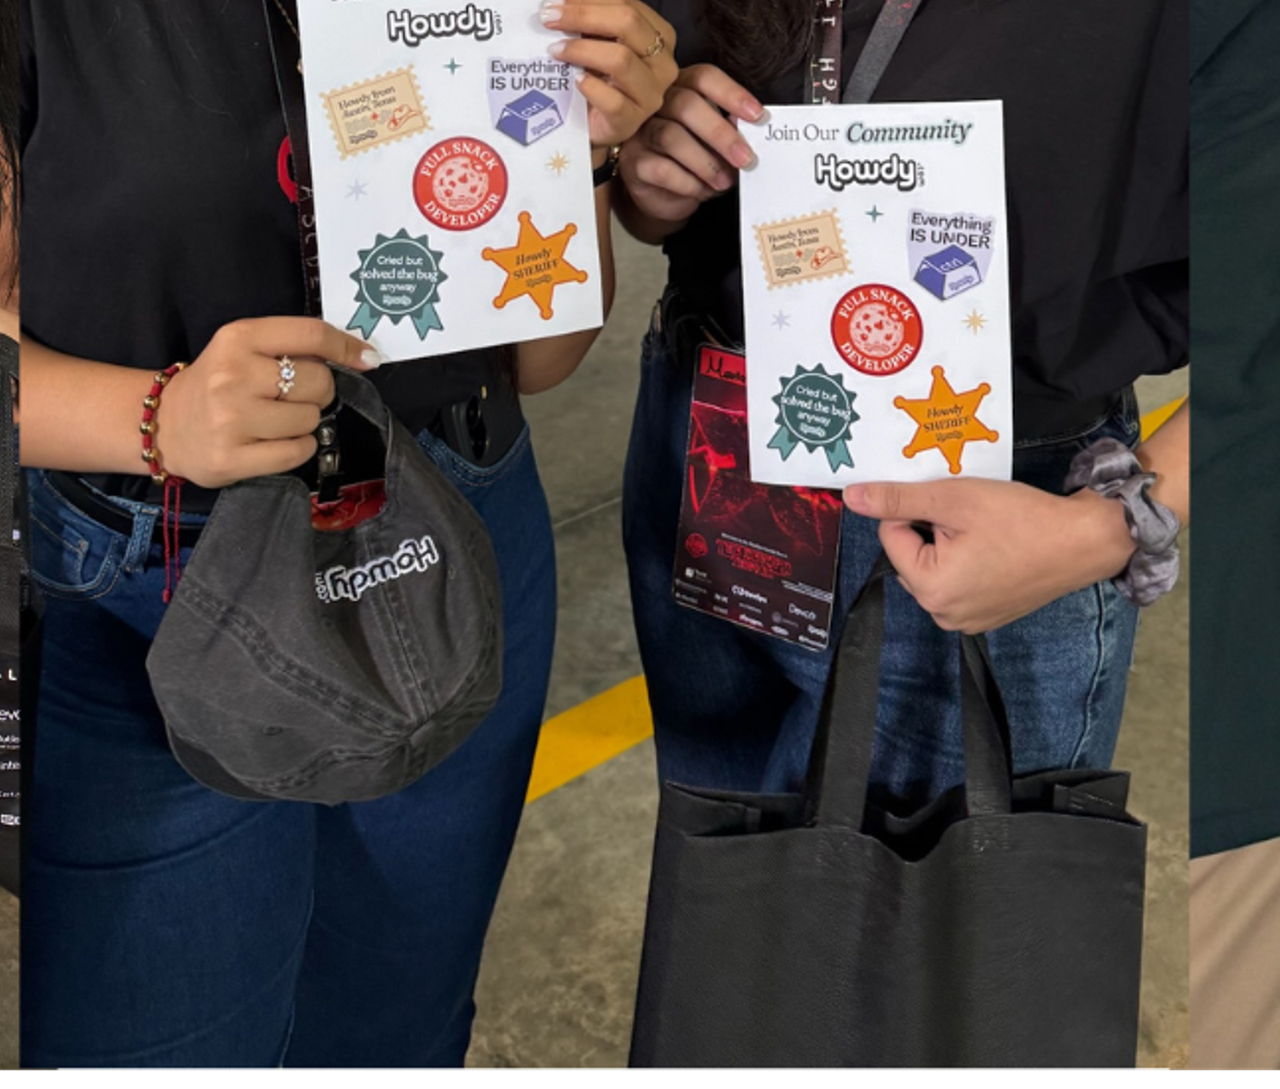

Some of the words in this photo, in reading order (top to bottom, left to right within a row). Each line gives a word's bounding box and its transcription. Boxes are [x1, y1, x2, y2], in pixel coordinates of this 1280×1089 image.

[387, 3, 494, 47] Howdy
[491, 60, 570, 77] Everything
[491, 76, 506, 90] IS
[511, 77, 570, 90] UNDER
[765, 124, 800, 142] Join
[803, 123, 839, 142] Our
[846, 119, 973, 144] Community
[421, 145, 452, 177] FULL
[452, 142, 499, 171] SNACK
[815, 153, 916, 191] Howdy
[424, 193, 501, 226] DEVELOPER
[911, 213, 991, 234] Everything
[910, 228, 926, 242] IS
[930, 229, 991, 249] UNDER
[377, 255, 403, 265] Cried
[406, 255, 423, 265] but
[515, 248, 552, 266] Howdy
[359, 268, 395, 280] solved
[397, 268, 415, 279] the
[416, 268, 438, 283] bug
[379, 283, 417, 294] anyway
[838, 290, 869, 319] FULL
[870, 289, 915, 321] SNACK
[840, 342, 915, 372] DEVELOPER
[796, 385, 820, 399] Cried
[821, 392, 838, 402] but
[781, 396, 814, 410] solved
[815, 401, 830, 413] the
[927, 404, 964, 419] Howdy
[327, 534, 439, 601] Howdy
